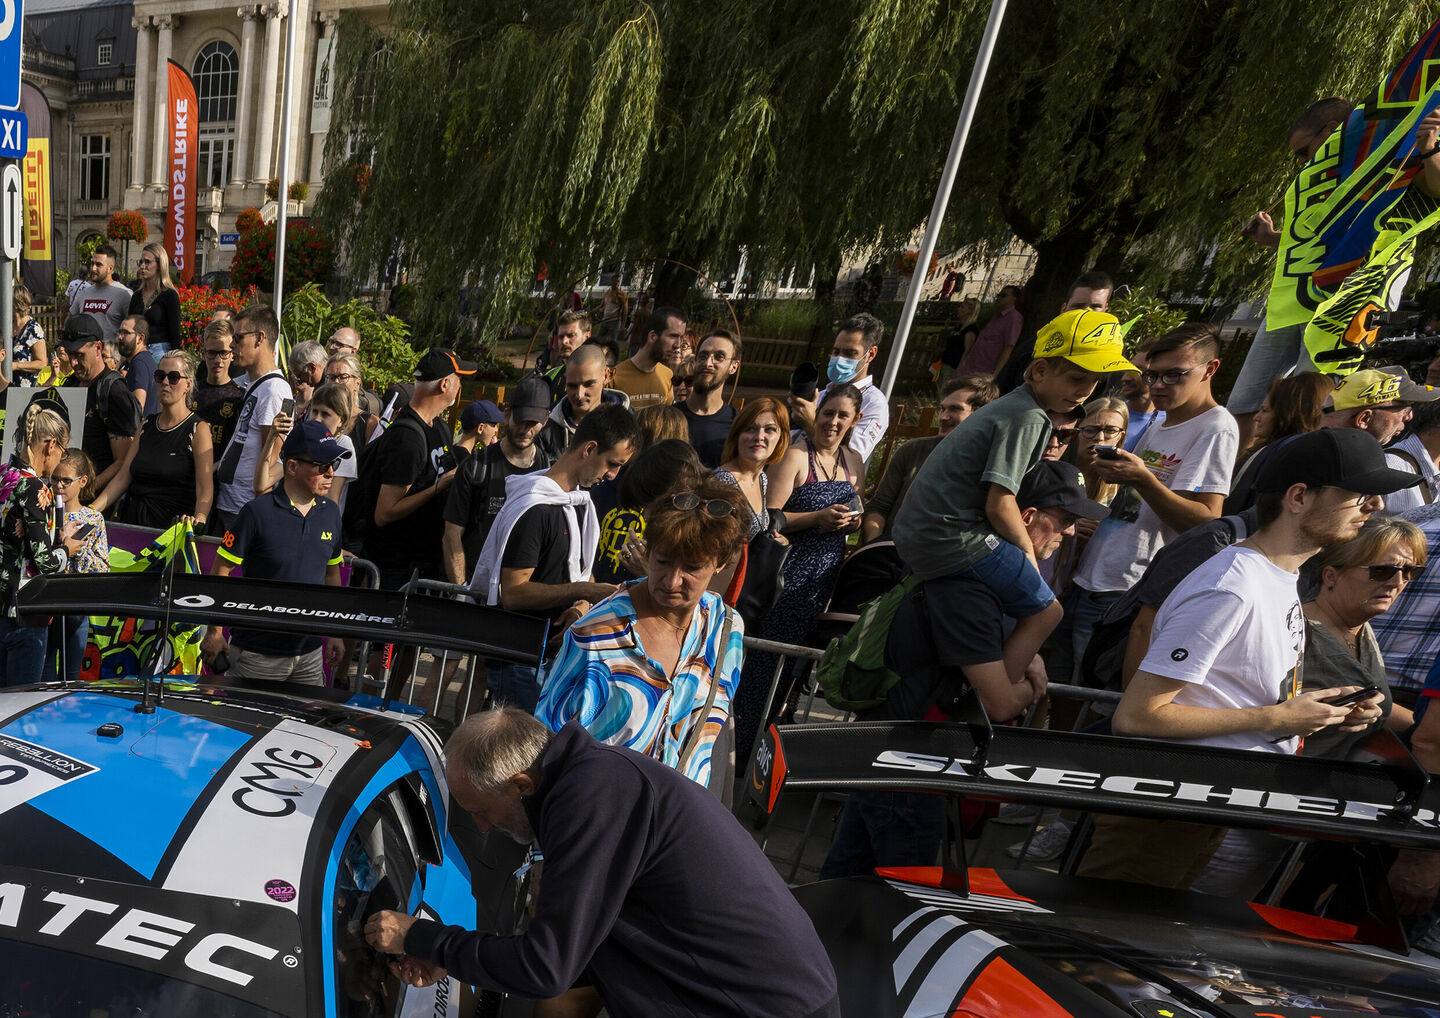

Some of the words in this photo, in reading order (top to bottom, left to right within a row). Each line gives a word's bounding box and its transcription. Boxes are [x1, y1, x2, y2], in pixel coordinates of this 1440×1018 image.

[1357, 376, 1402, 400] 46
[223, 601, 395, 624] DELABOUDINIÈRE
[232, 747, 324, 818] CMG
[872, 750, 1440, 829] SKECHER
[267, 886, 294, 895] 2022
